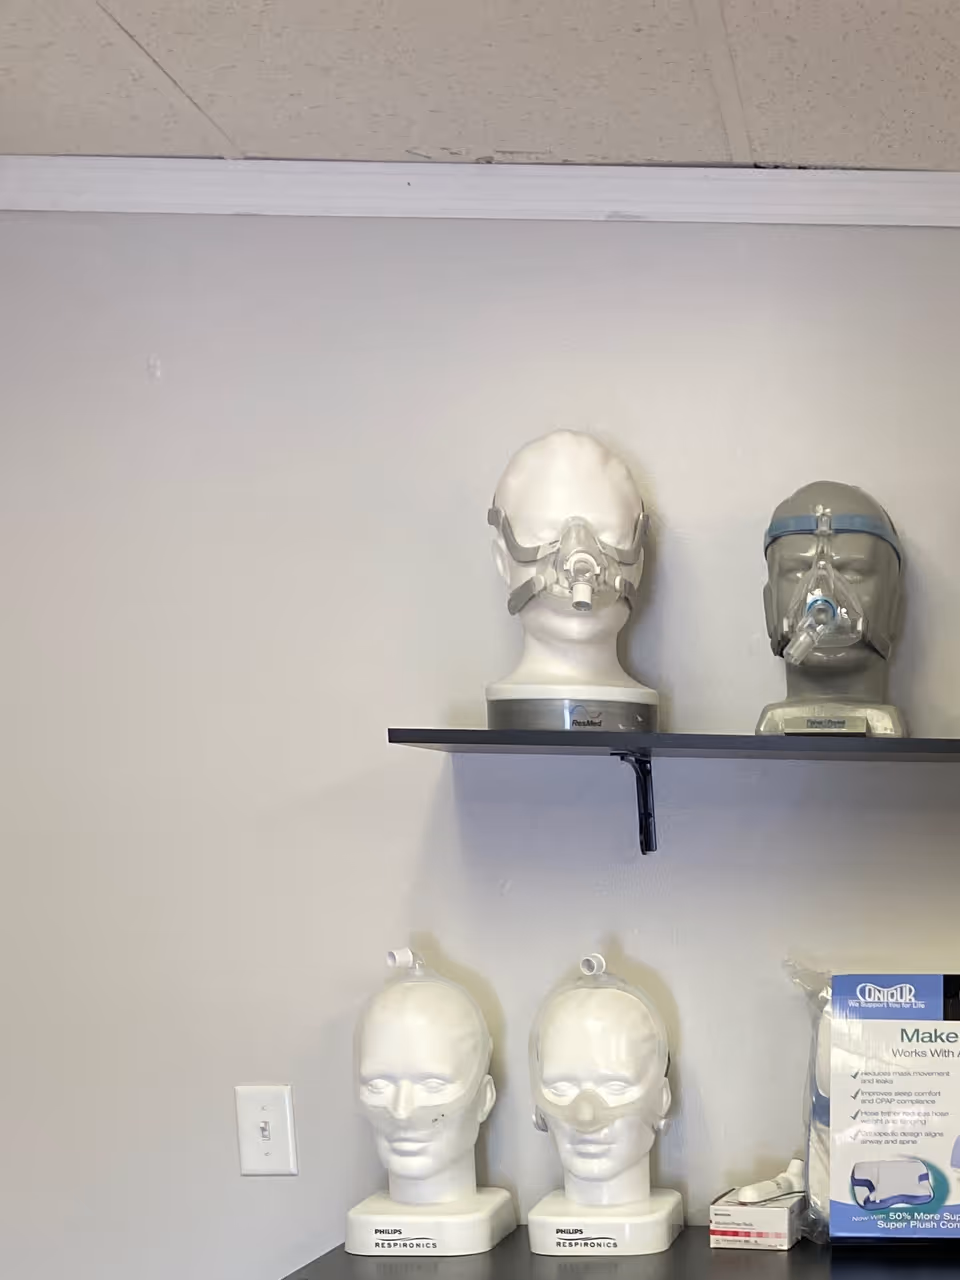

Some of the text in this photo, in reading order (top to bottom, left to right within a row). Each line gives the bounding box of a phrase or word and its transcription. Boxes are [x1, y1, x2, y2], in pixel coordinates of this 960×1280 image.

[856, 983, 916, 1002] CONTOUR
[912, 1001, 925, 1009] Life
[900, 1028, 959, 1044] Make
[892, 1048, 927, 1058] Works
[929, 1048, 955, 1058] With
[888, 1212, 912, 1220] 50%
[914, 1212, 940, 1220] More
[877, 1220, 907, 1229] Super
[910, 1220, 937, 1229] Plush
